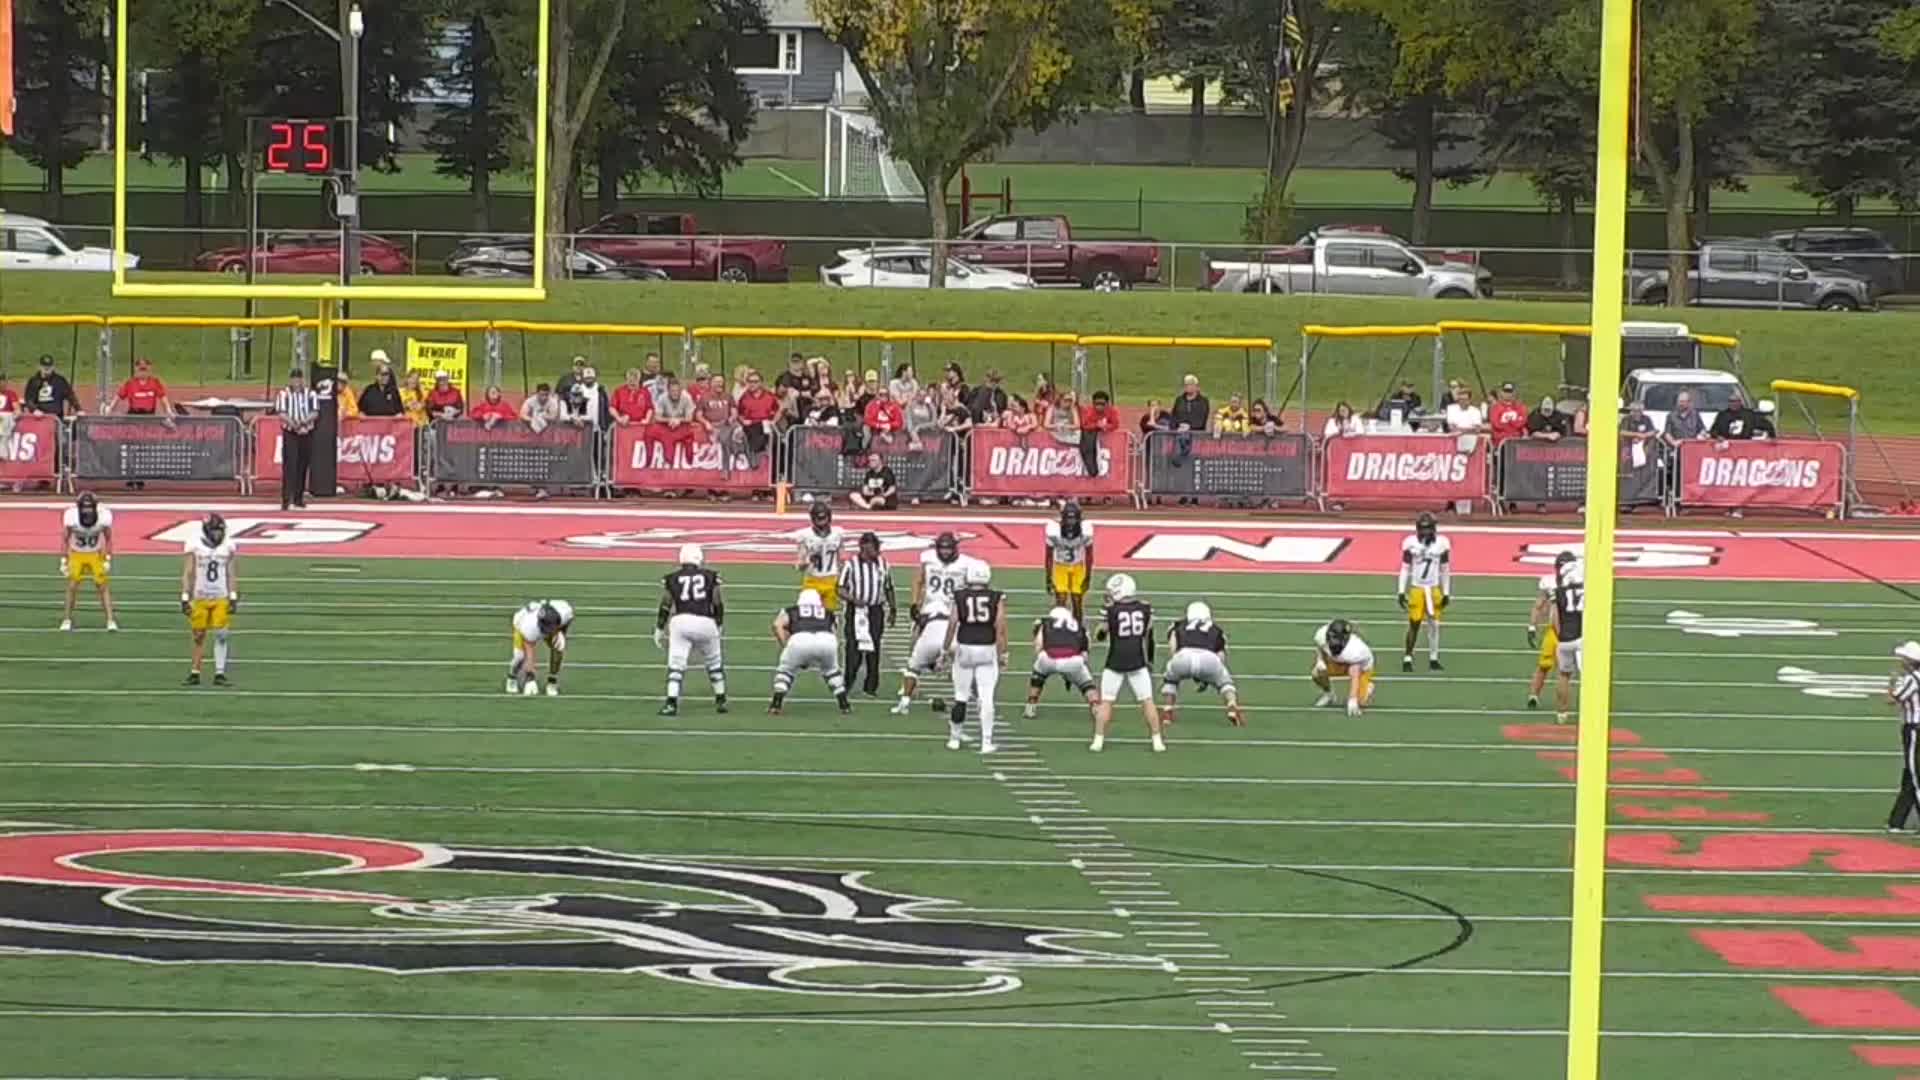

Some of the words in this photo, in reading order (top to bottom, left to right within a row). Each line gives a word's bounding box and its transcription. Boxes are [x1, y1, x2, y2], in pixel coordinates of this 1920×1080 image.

[267, 123, 327, 169] 25
[418, 346, 457, 359] BEWARE
[1346, 452, 1468, 481] DRAGONS
[1698, 457, 1820, 488] DRAGONS
[207, 560, 219, 582] 8
[1420, 558, 1432, 580] 7
[677, 574, 707, 602] 72
[965, 596, 991, 623] 15
[1117, 610, 1145, 637] 26
